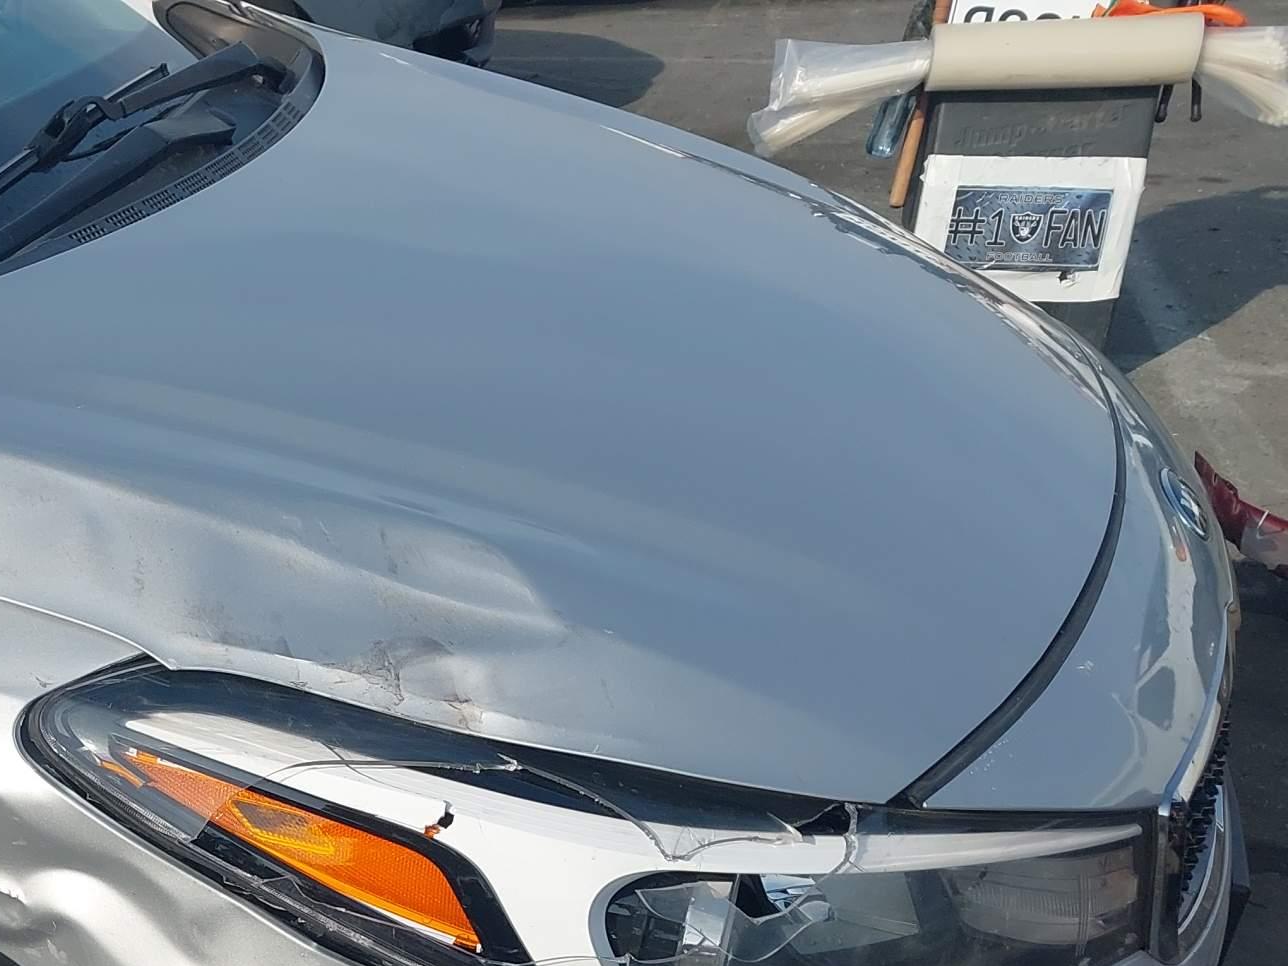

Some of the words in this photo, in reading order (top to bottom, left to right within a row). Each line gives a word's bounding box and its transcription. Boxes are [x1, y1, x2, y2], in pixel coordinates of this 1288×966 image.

[998, 192, 1065, 205] RAIDERS
[948, 206, 1006, 247] #1
[1042, 206, 1107, 249] FAN
[985, 251, 1053, 263] FOOTBALL
